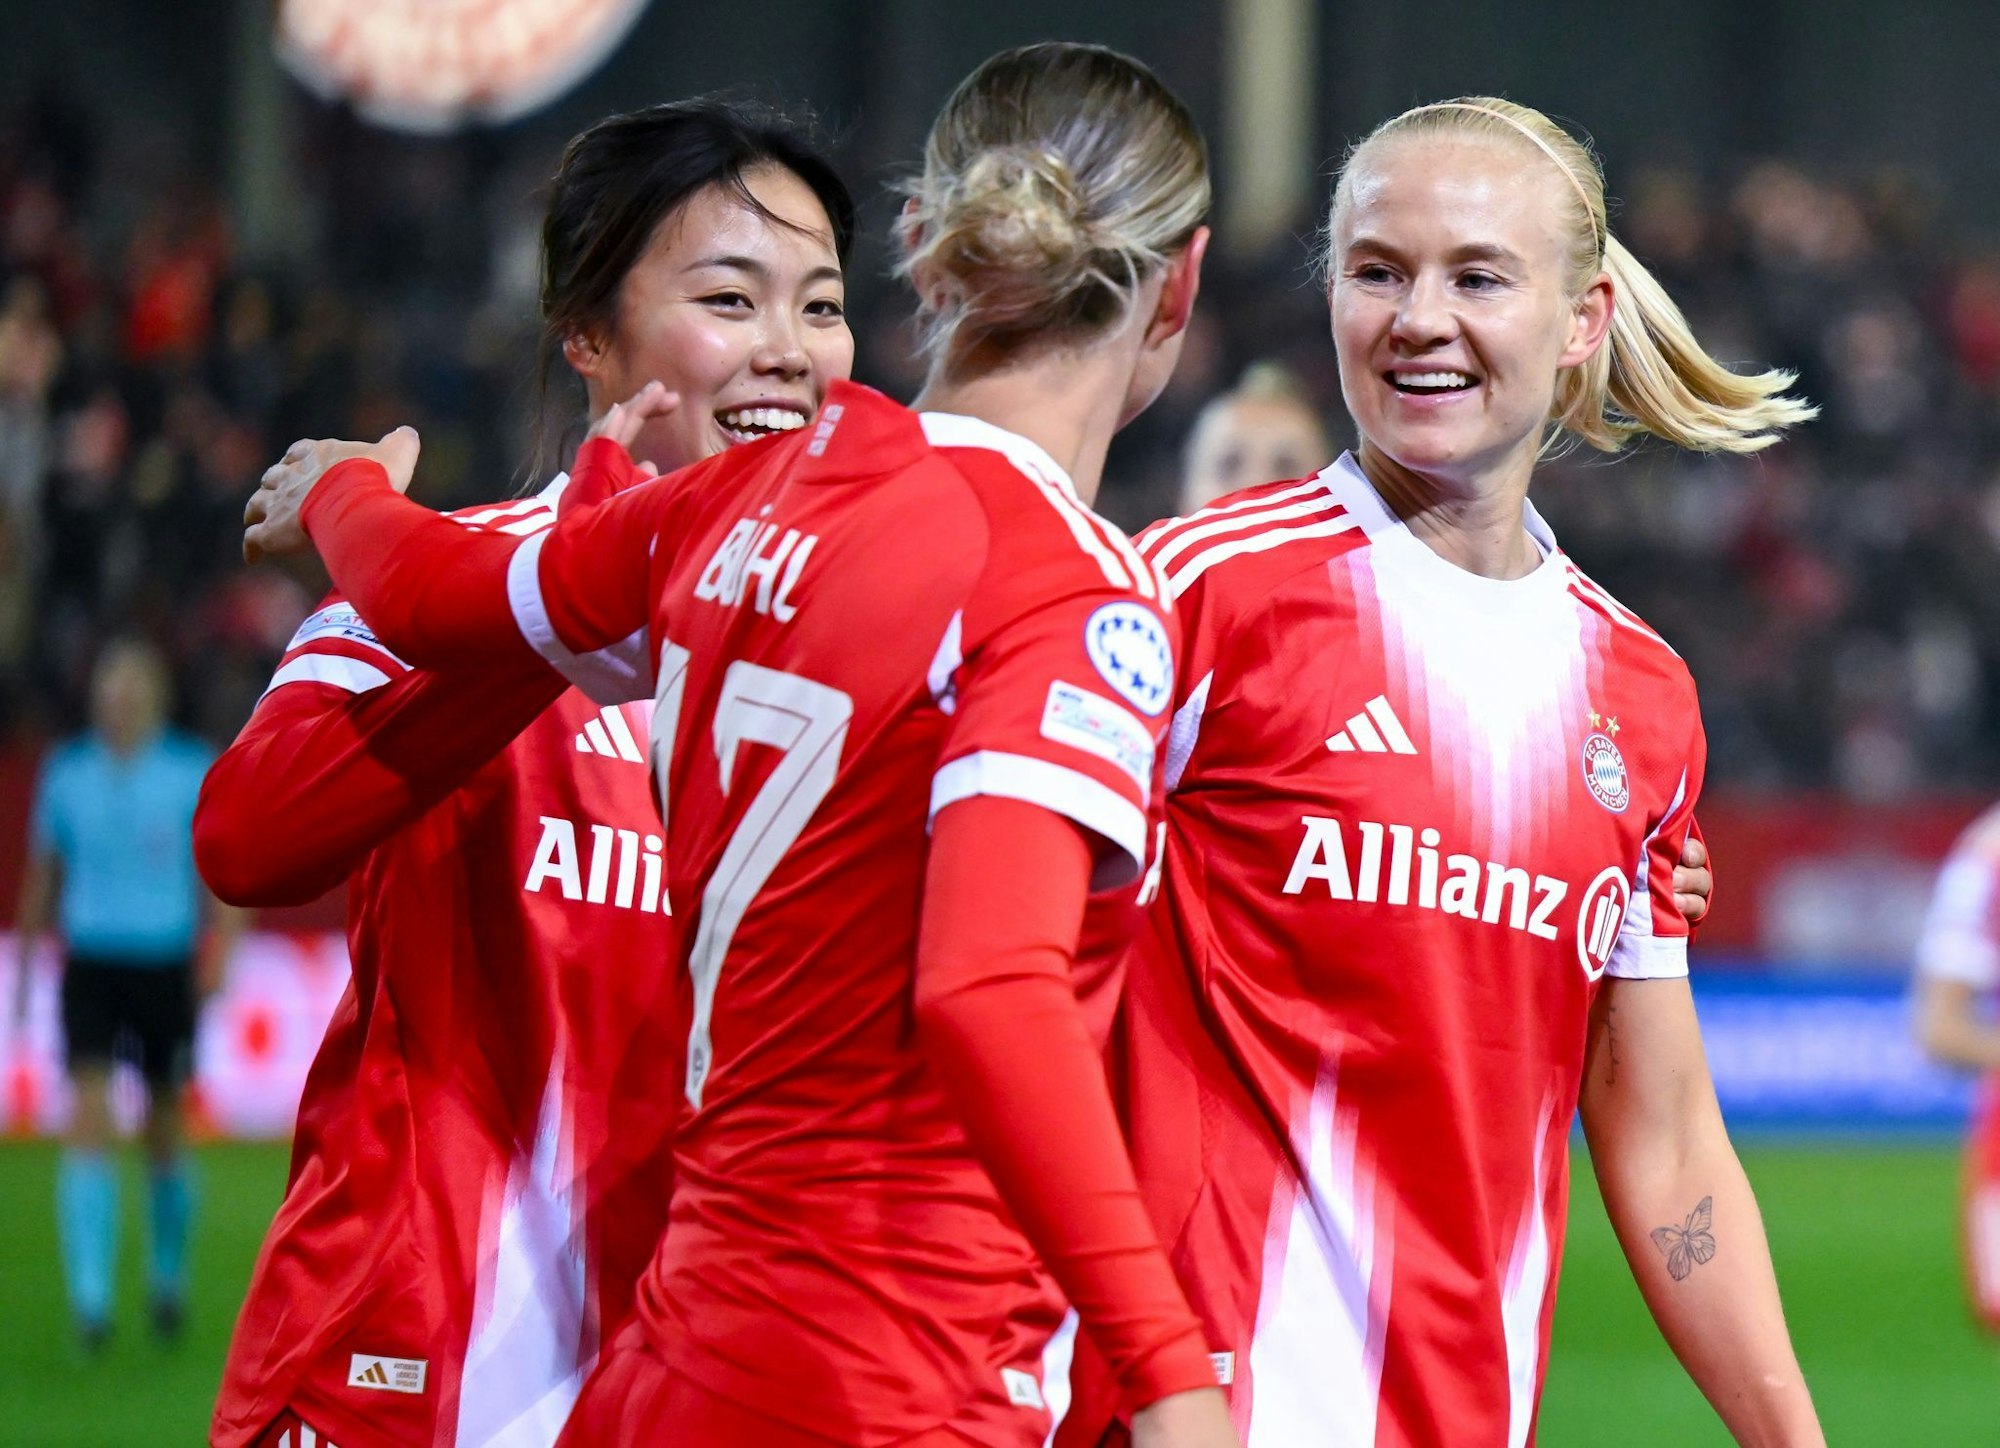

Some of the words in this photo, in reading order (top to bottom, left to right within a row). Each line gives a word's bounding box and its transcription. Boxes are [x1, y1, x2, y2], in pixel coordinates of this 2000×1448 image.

[1594, 739, 1626, 776] BAYERN
[524, 815, 672, 917] Alli
[1282, 815, 1568, 941] Allianz
